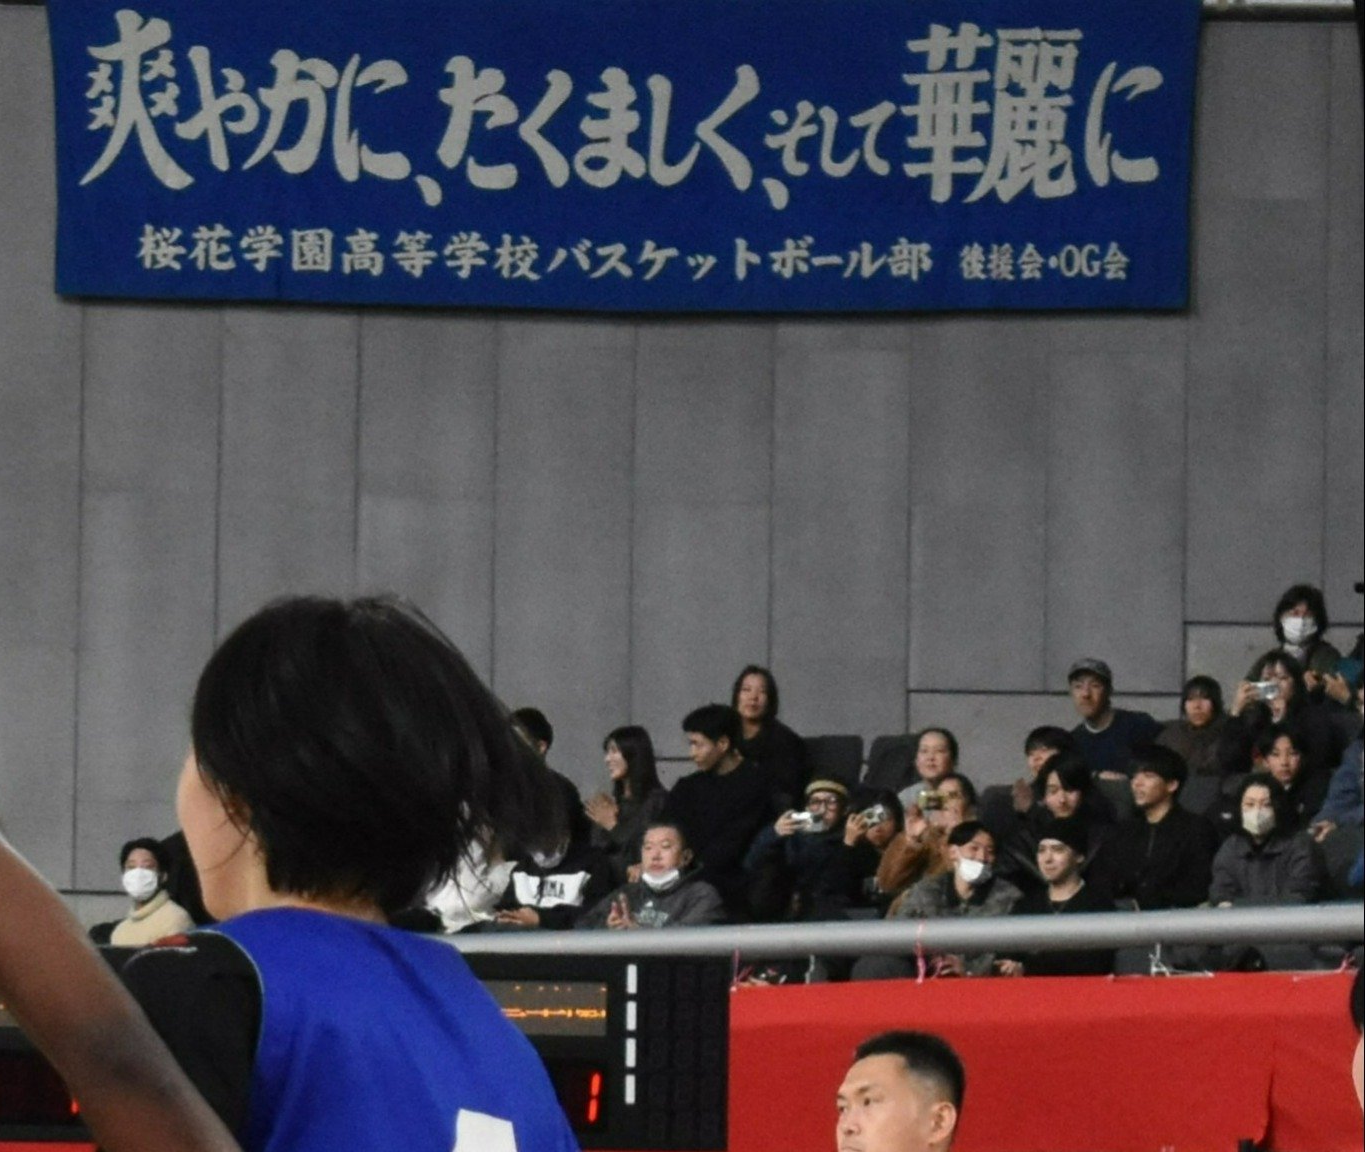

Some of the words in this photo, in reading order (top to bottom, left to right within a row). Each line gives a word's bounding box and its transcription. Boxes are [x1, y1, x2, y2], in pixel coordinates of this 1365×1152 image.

[79, 9, 1164, 210] 爽やかに、たくましく、そして華麗に
[137, 224, 933, 282] 桜花学園高等学校バスケットボール部
